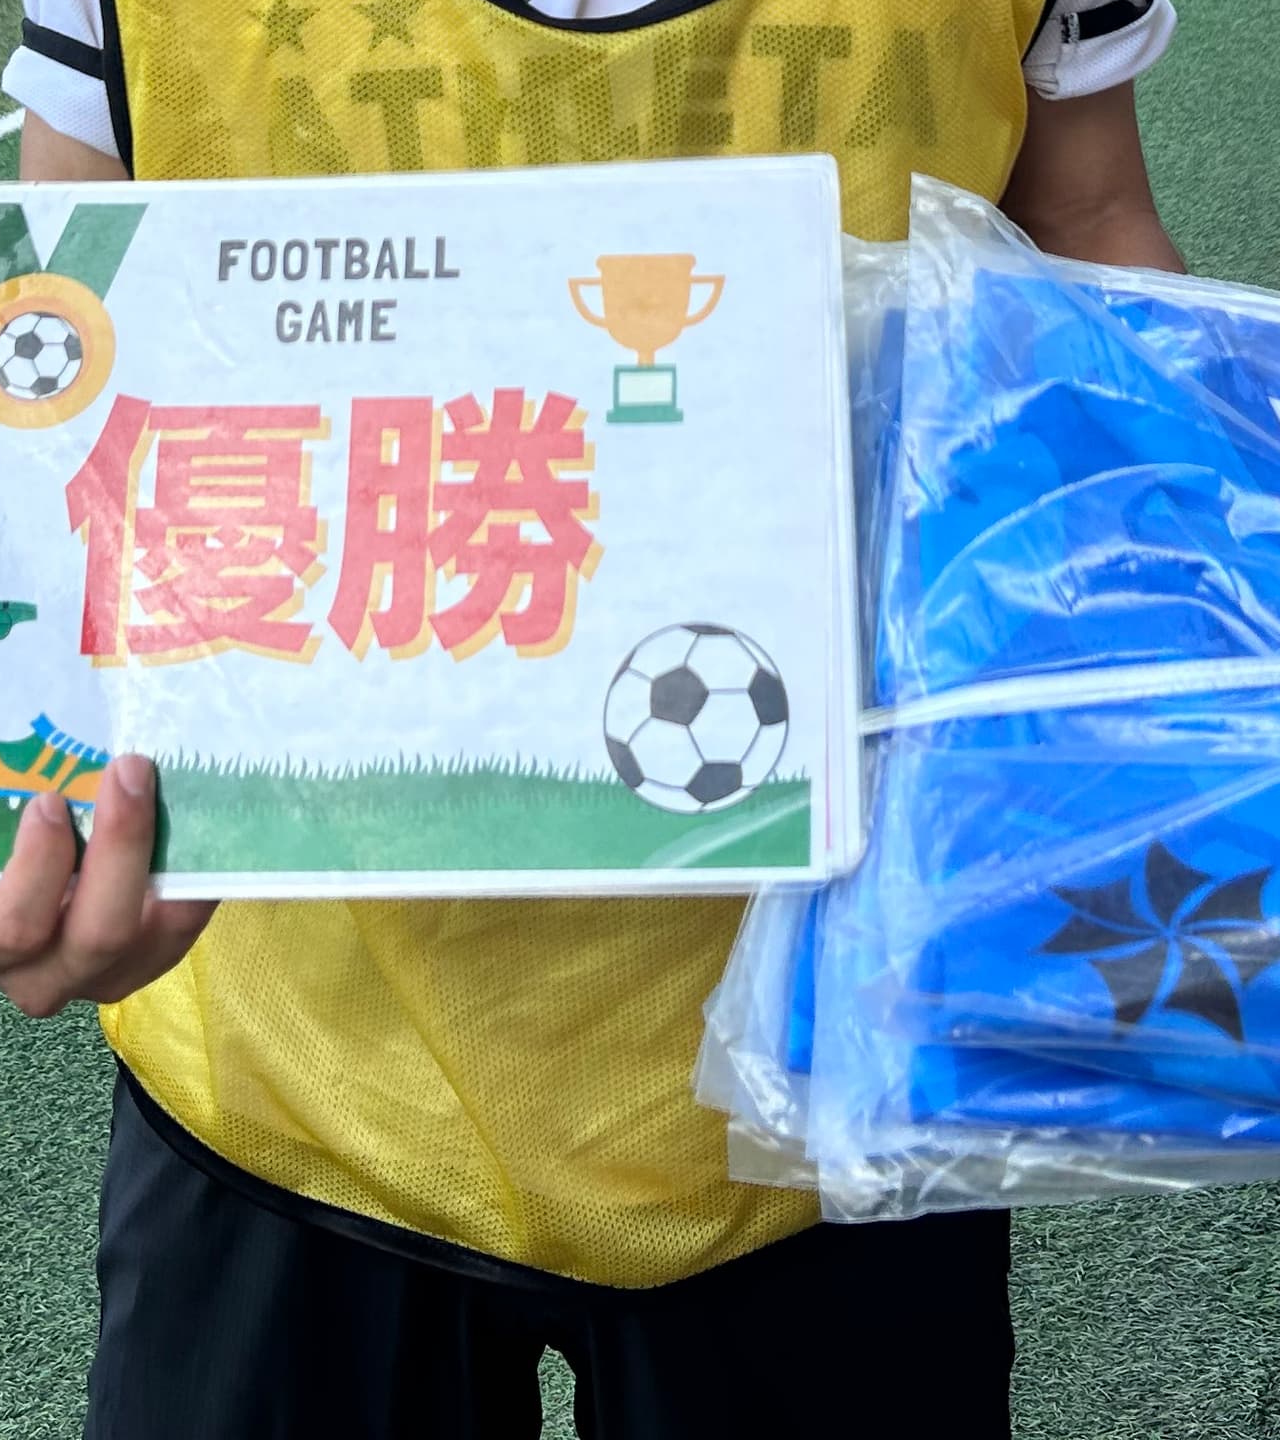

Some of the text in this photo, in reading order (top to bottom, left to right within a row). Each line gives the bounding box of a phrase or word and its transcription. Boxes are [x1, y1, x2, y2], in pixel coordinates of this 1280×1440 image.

[216, 237, 461, 281] FOOTBALL
[274, 299, 399, 343] GAME
[64, 386, 604, 666] 優勝
